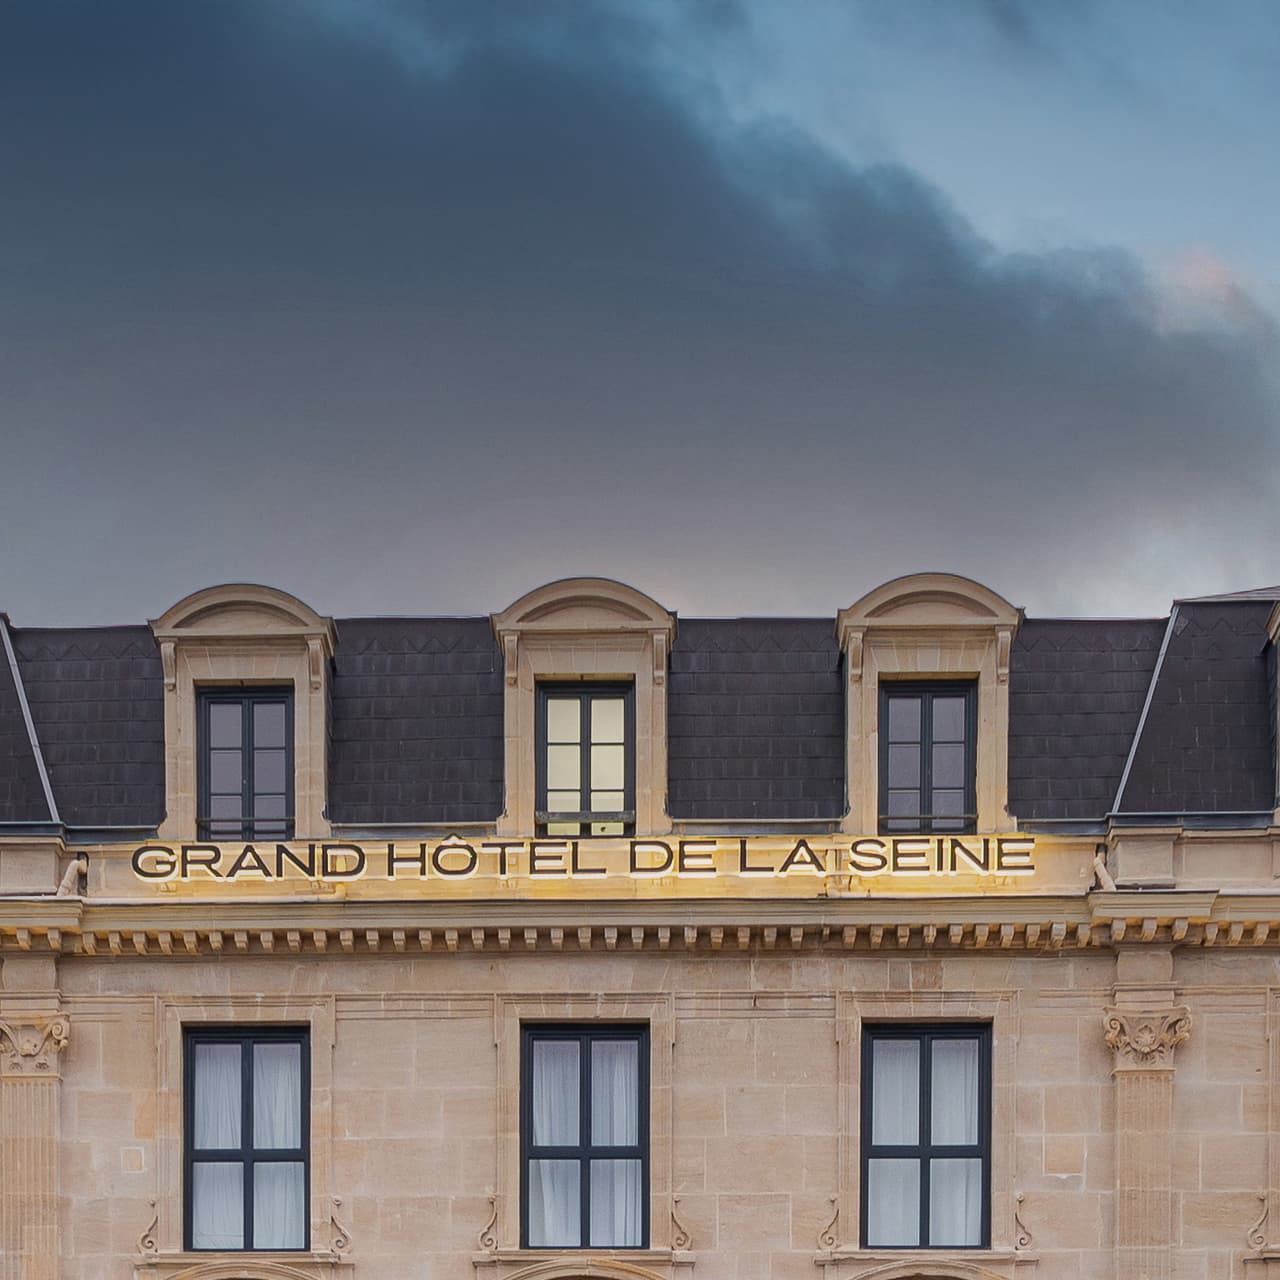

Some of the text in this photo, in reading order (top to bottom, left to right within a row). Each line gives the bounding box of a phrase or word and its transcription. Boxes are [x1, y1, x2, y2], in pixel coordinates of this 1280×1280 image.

[131, 832, 1036, 880] GRAND HÔTEL DE LA SEINE
